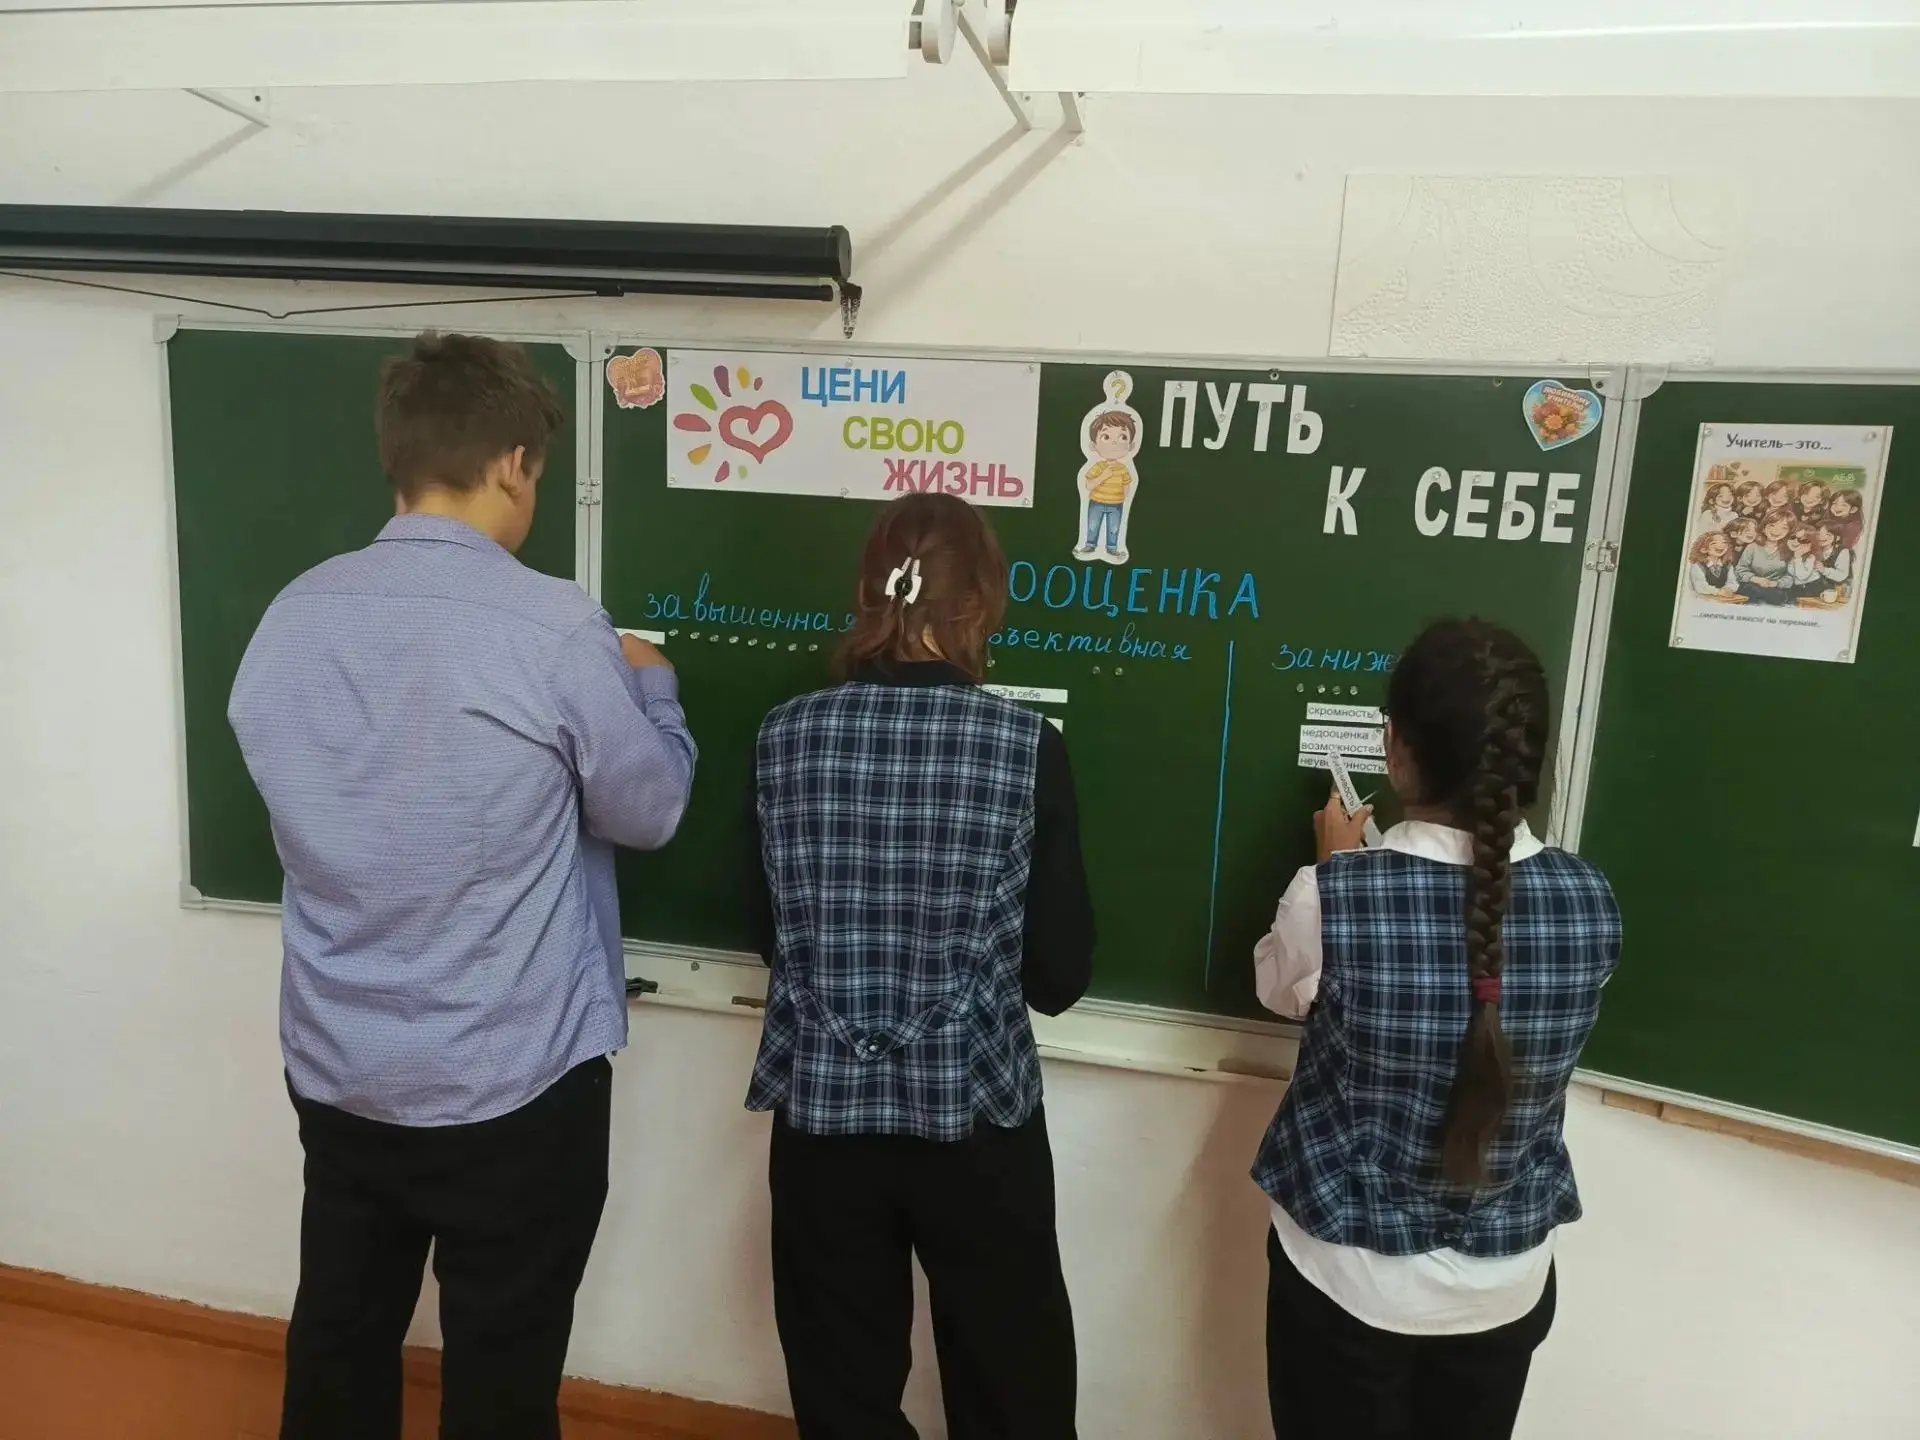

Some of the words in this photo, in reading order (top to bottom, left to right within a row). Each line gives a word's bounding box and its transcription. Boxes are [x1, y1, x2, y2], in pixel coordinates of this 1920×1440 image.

[801, 366, 906, 408] ЦЕНИ
[843, 415, 965, 455] СВОЮ
[1159, 380, 1324, 455] ПУТЬ
[883, 458, 1024, 498] ЖИЗНЬ
[1323, 465, 1367, 536] К
[1414, 466, 1581, 544] СЕБЕ
[643, 572, 858, 633] завышенная
[1017, 690, 1041, 700] себе
[1308, 707, 1374, 719] скромность
[1302, 729, 1369, 740] недооценка
